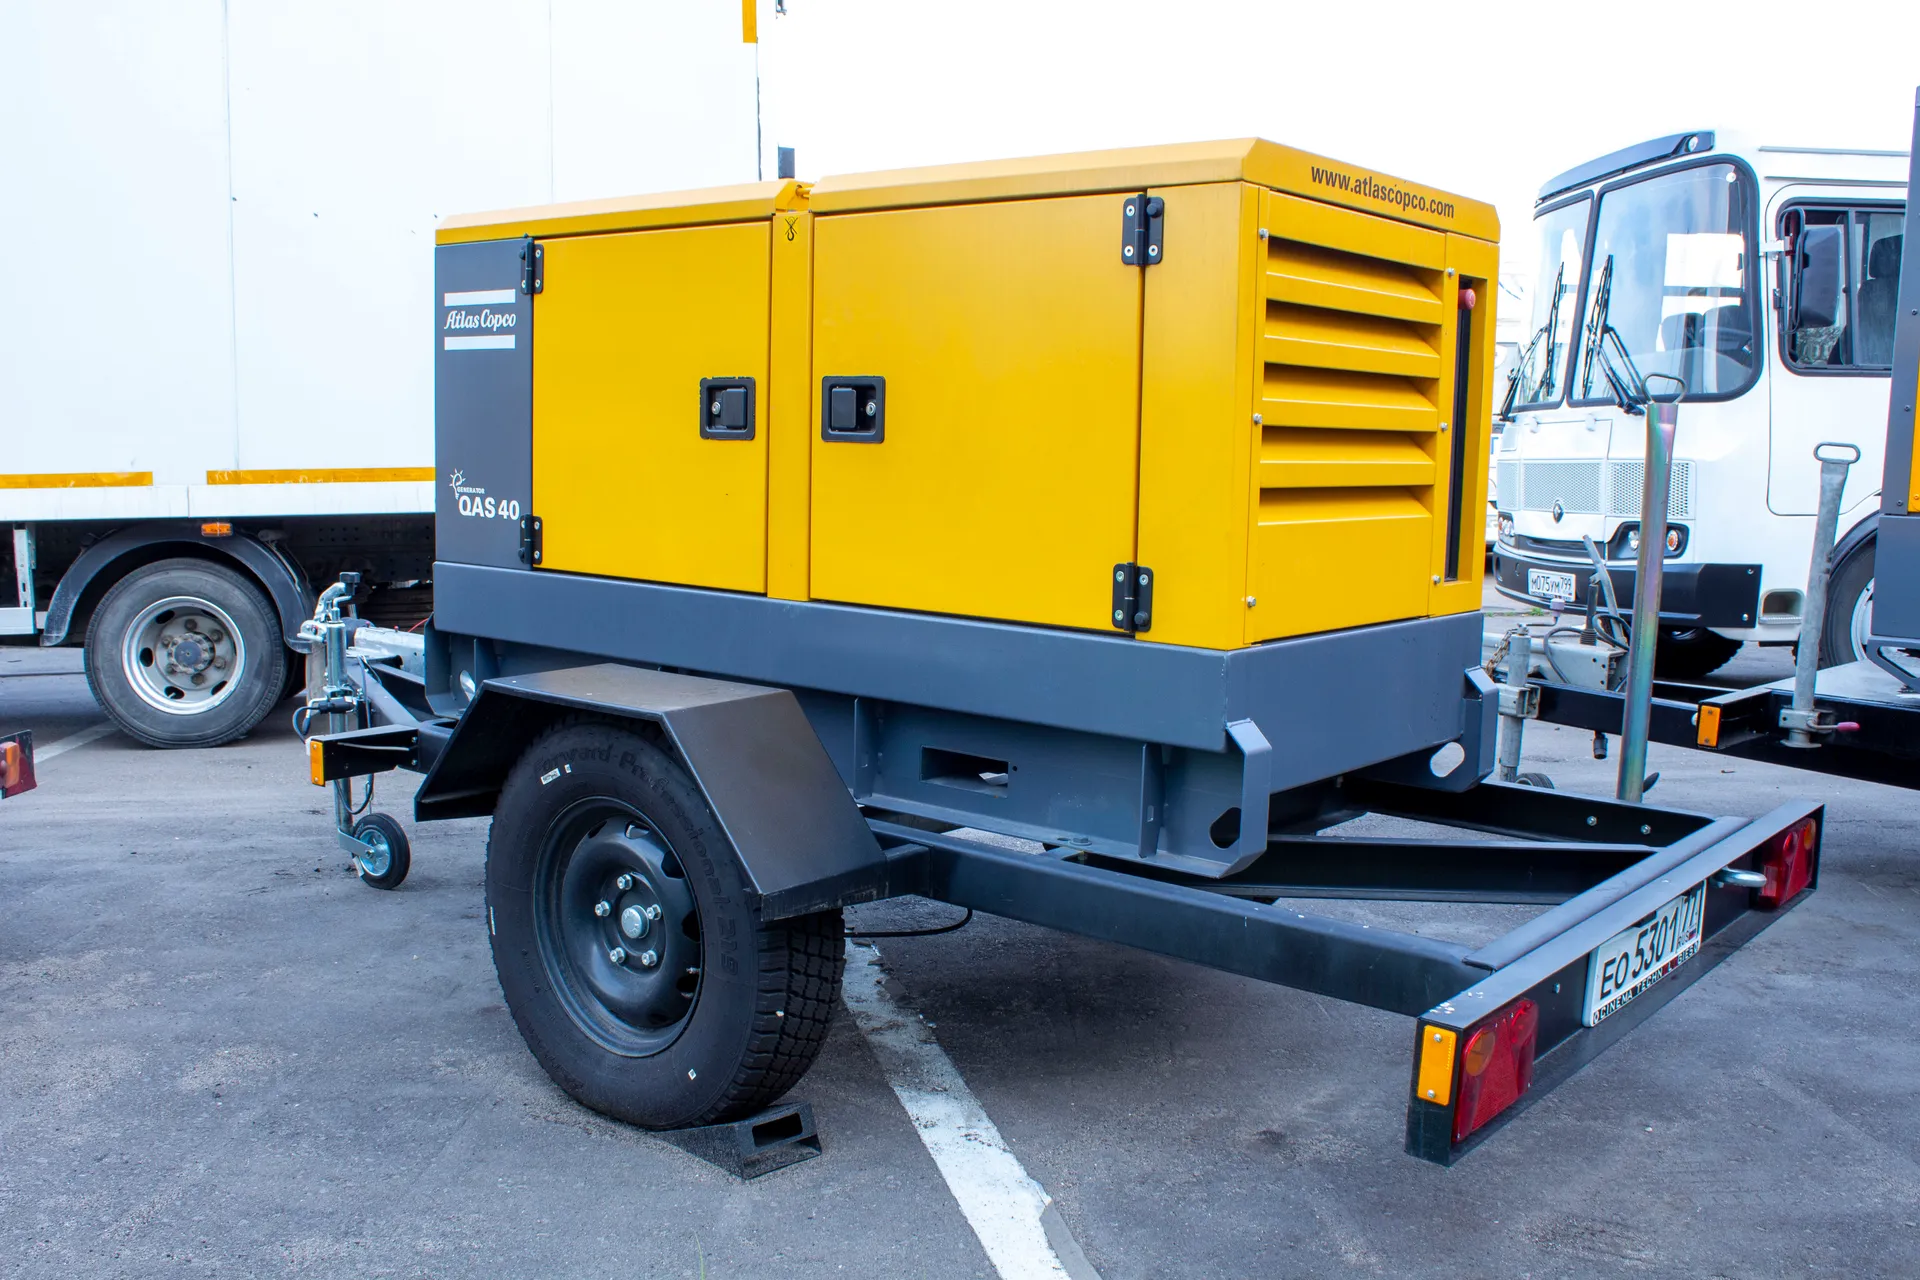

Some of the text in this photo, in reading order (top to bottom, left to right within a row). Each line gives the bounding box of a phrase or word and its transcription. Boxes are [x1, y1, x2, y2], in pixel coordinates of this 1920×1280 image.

[1311, 165, 1455, 219] www.atlascopco.com
[444, 309, 516, 332] Atlas Copco
[457, 486, 485, 494] GENERATOR
[459, 495, 520, 520] QAS 40
[534, 743, 614, 775] Forward
[1631, 905, 1679, 979] 5301
[1600, 988, 1633, 1020] CINEMA
